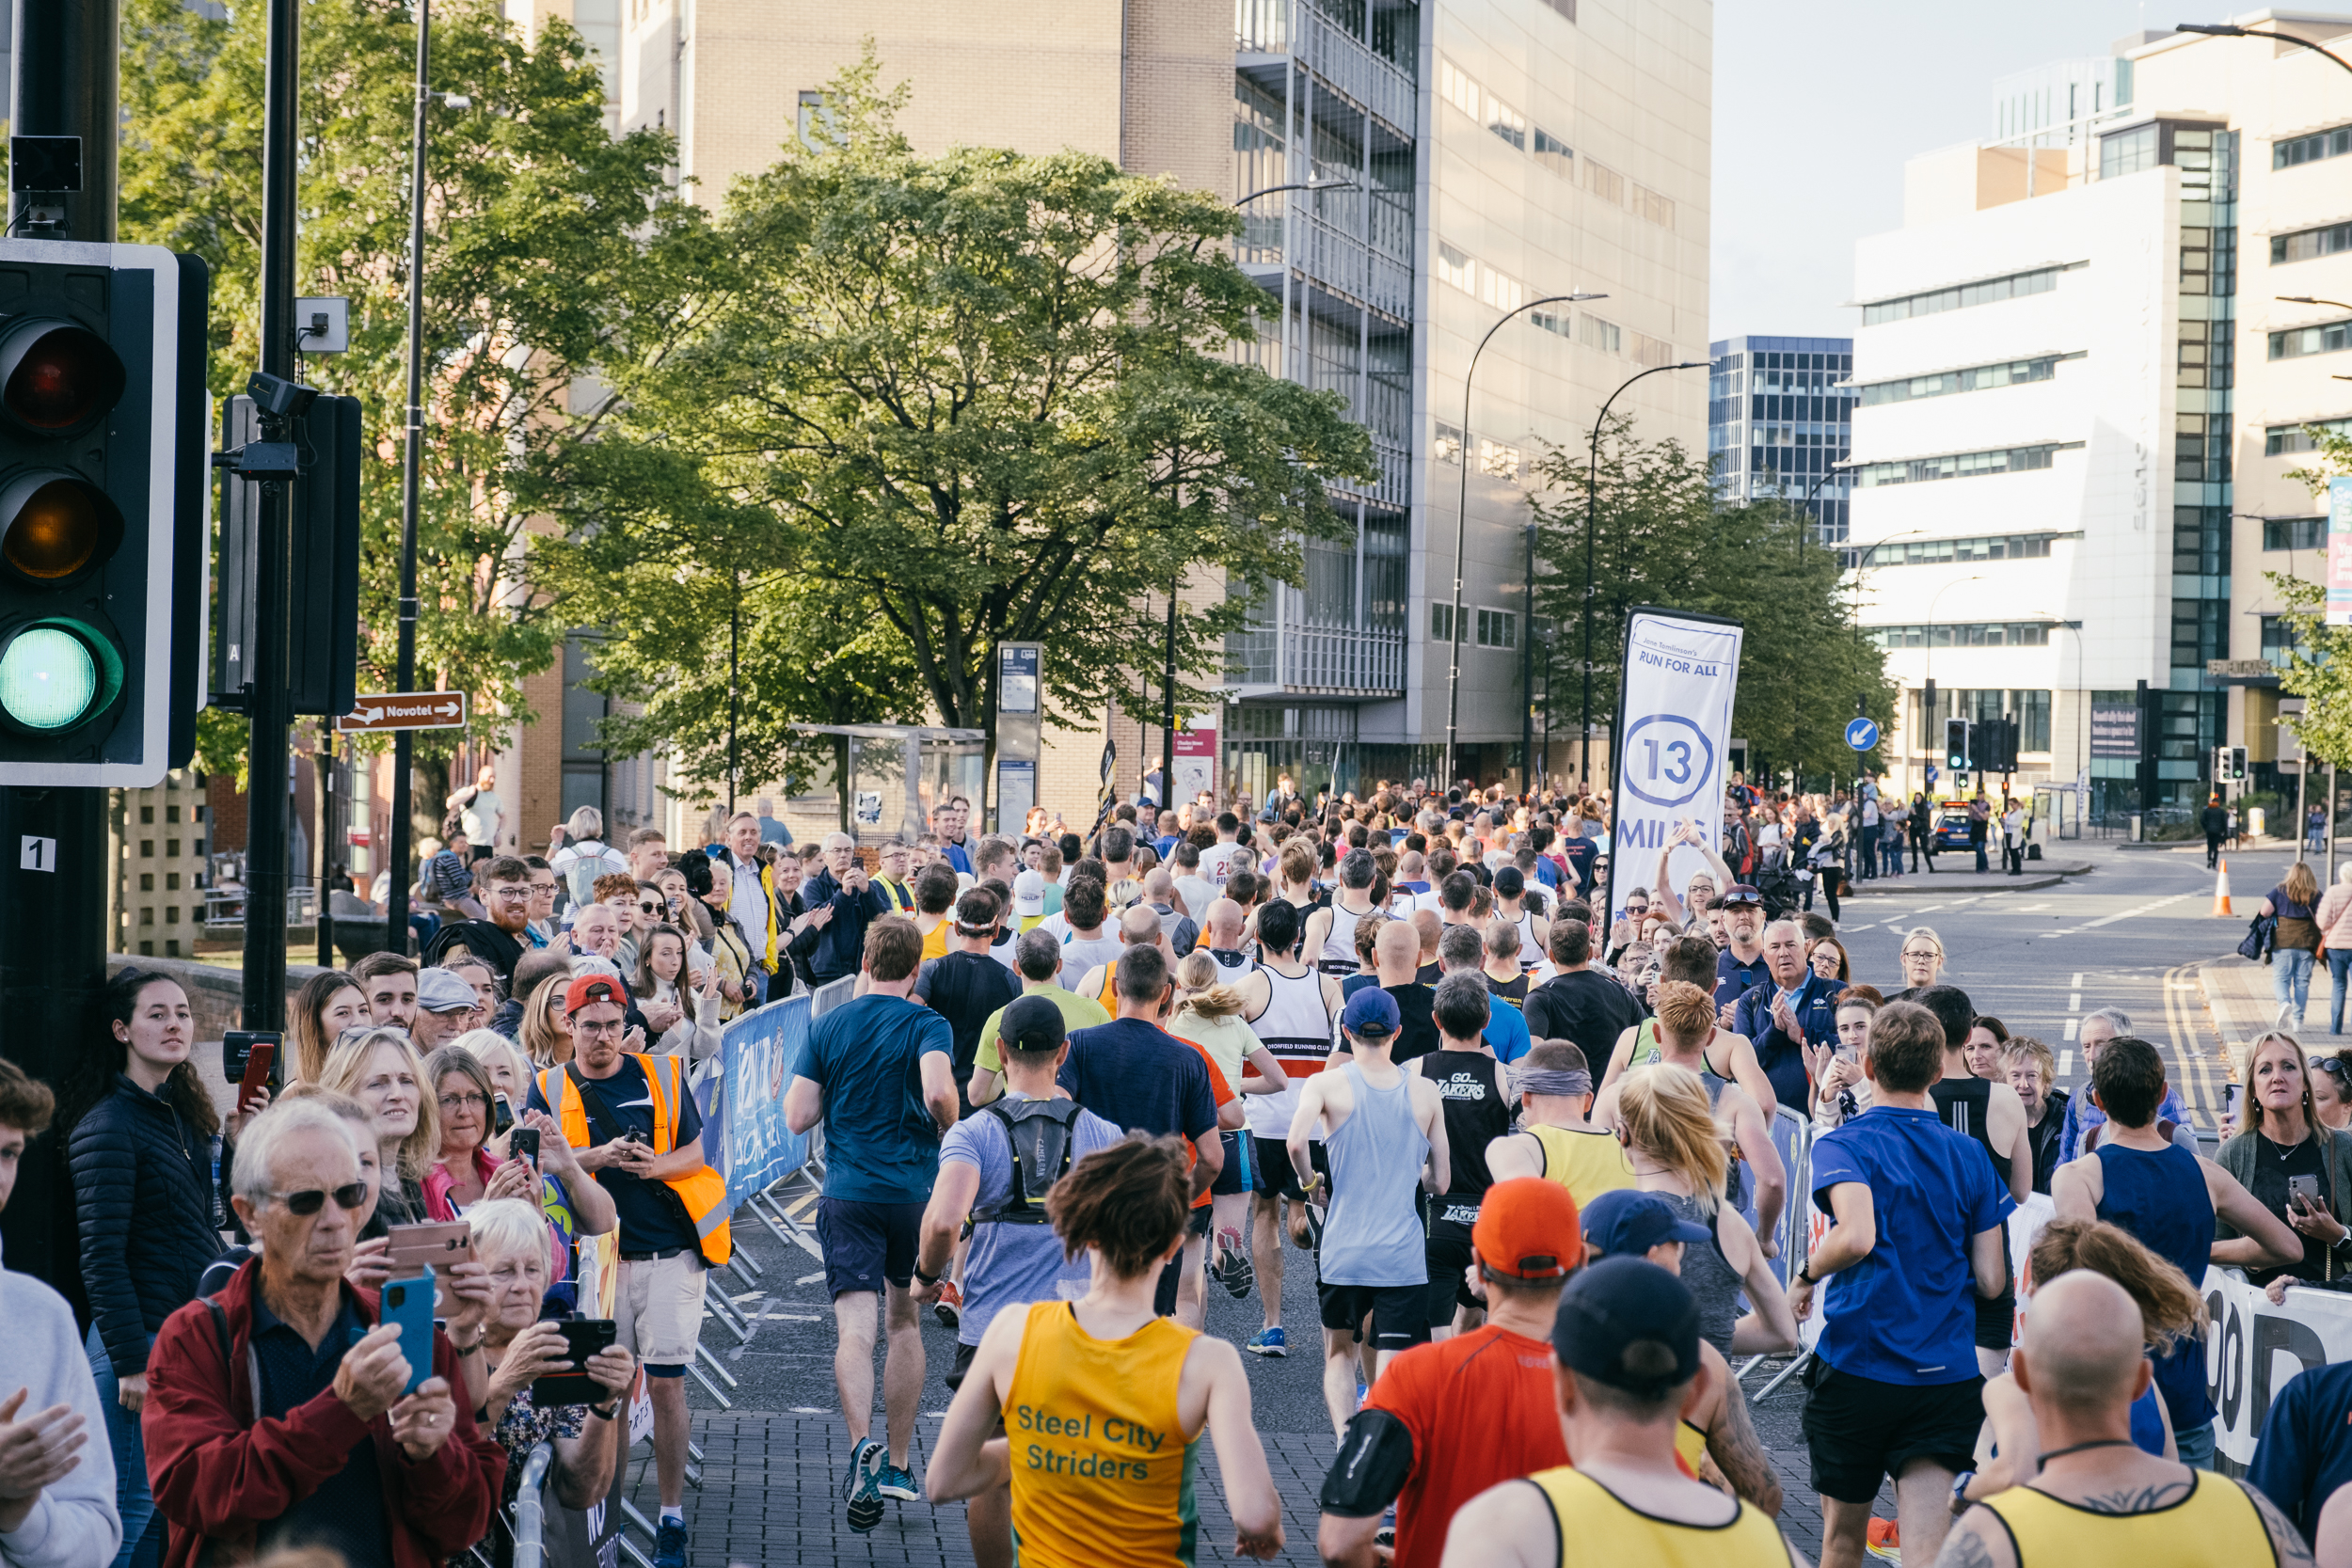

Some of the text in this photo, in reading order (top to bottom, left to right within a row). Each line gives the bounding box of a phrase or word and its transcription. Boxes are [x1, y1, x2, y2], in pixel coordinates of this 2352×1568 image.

[230, 645, 239, 660] A
[1643, 637, 1697, 657] Jane Tomlinson's
[1639, 650, 1718, 677] RUN FOR ALL
[387, 705, 433, 718] Novotel
[1644, 738, 1692, 784] 13
[28, 839, 42, 868] 1
[1036, 1138, 1045, 1177] CAMELBAK
[1018, 1404, 1166, 1453] Steel City
[1026, 1444, 1149, 1481] Striders
